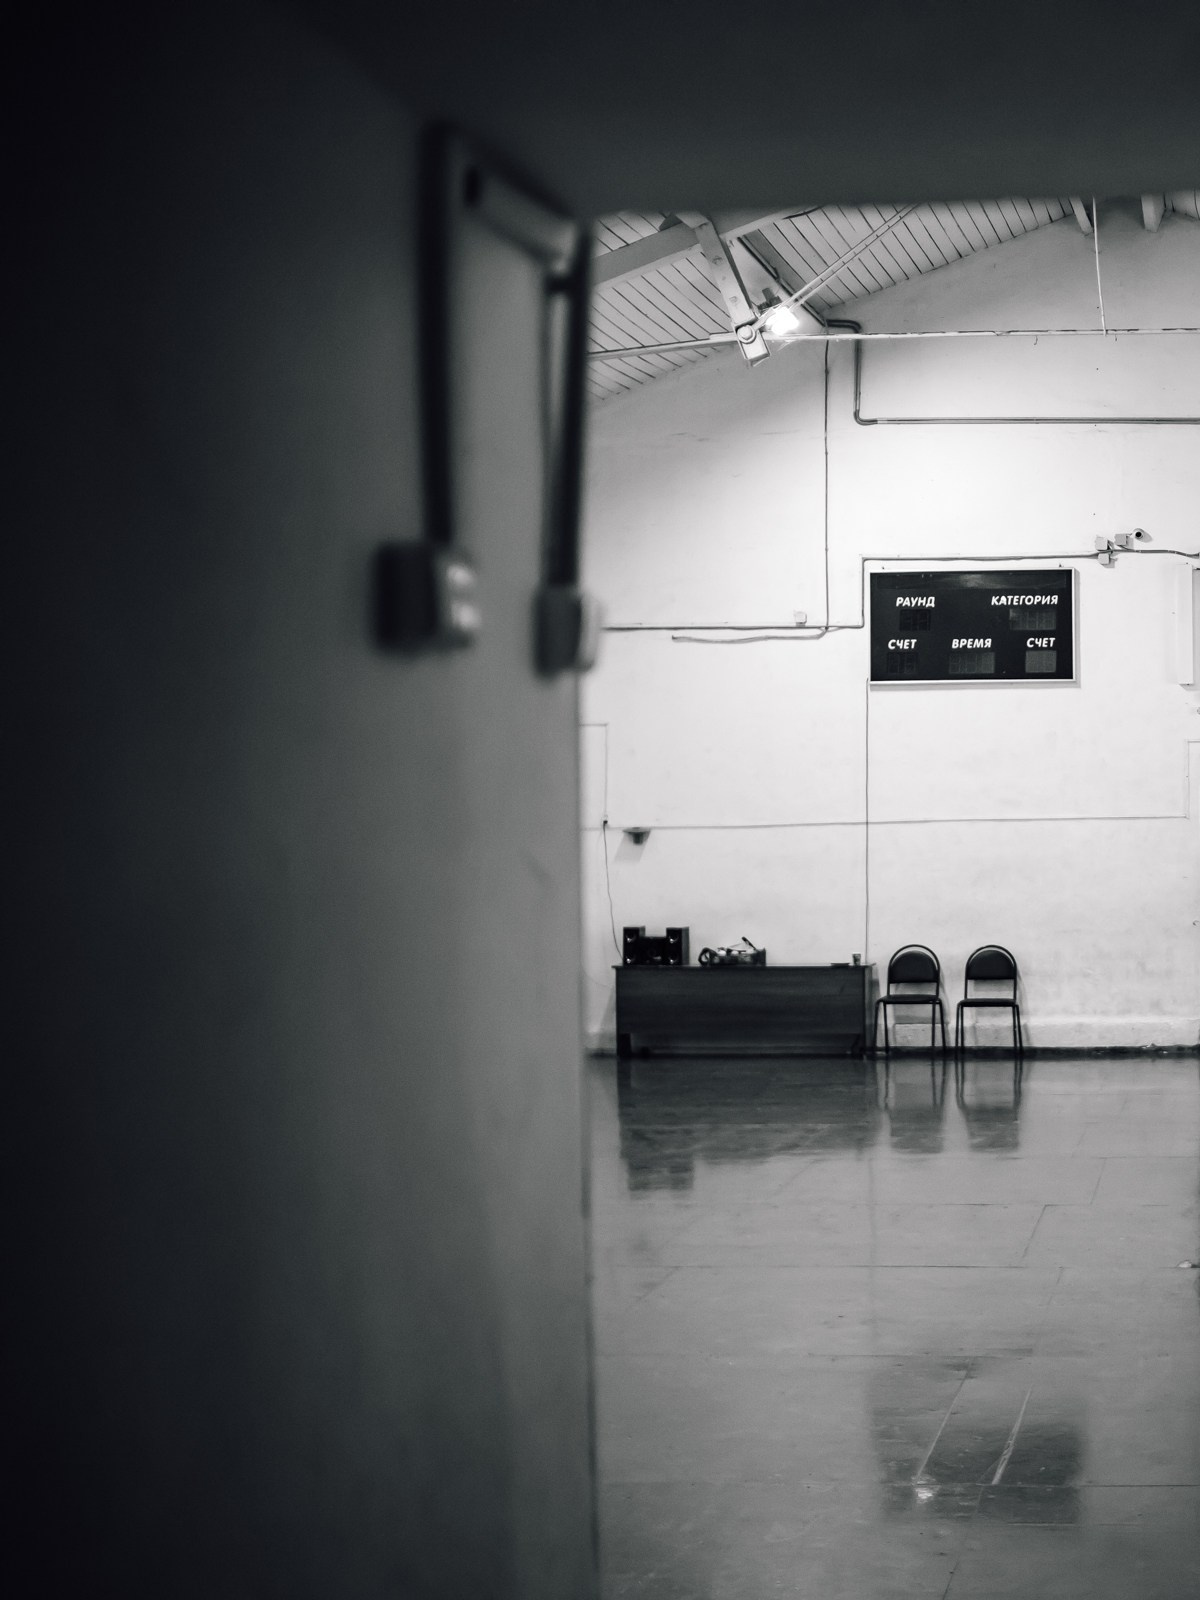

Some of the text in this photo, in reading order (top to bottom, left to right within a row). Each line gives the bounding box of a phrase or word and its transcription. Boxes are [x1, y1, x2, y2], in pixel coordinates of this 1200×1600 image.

[896, 596, 936, 608] РАУНД
[991, 595, 1059, 606] КАТЕГОРИЯ
[887, 639, 917, 650] СЧЕТ
[951, 638, 992, 649] ВРЕМЯ
[1027, 637, 1056, 648] СЧЕТ
